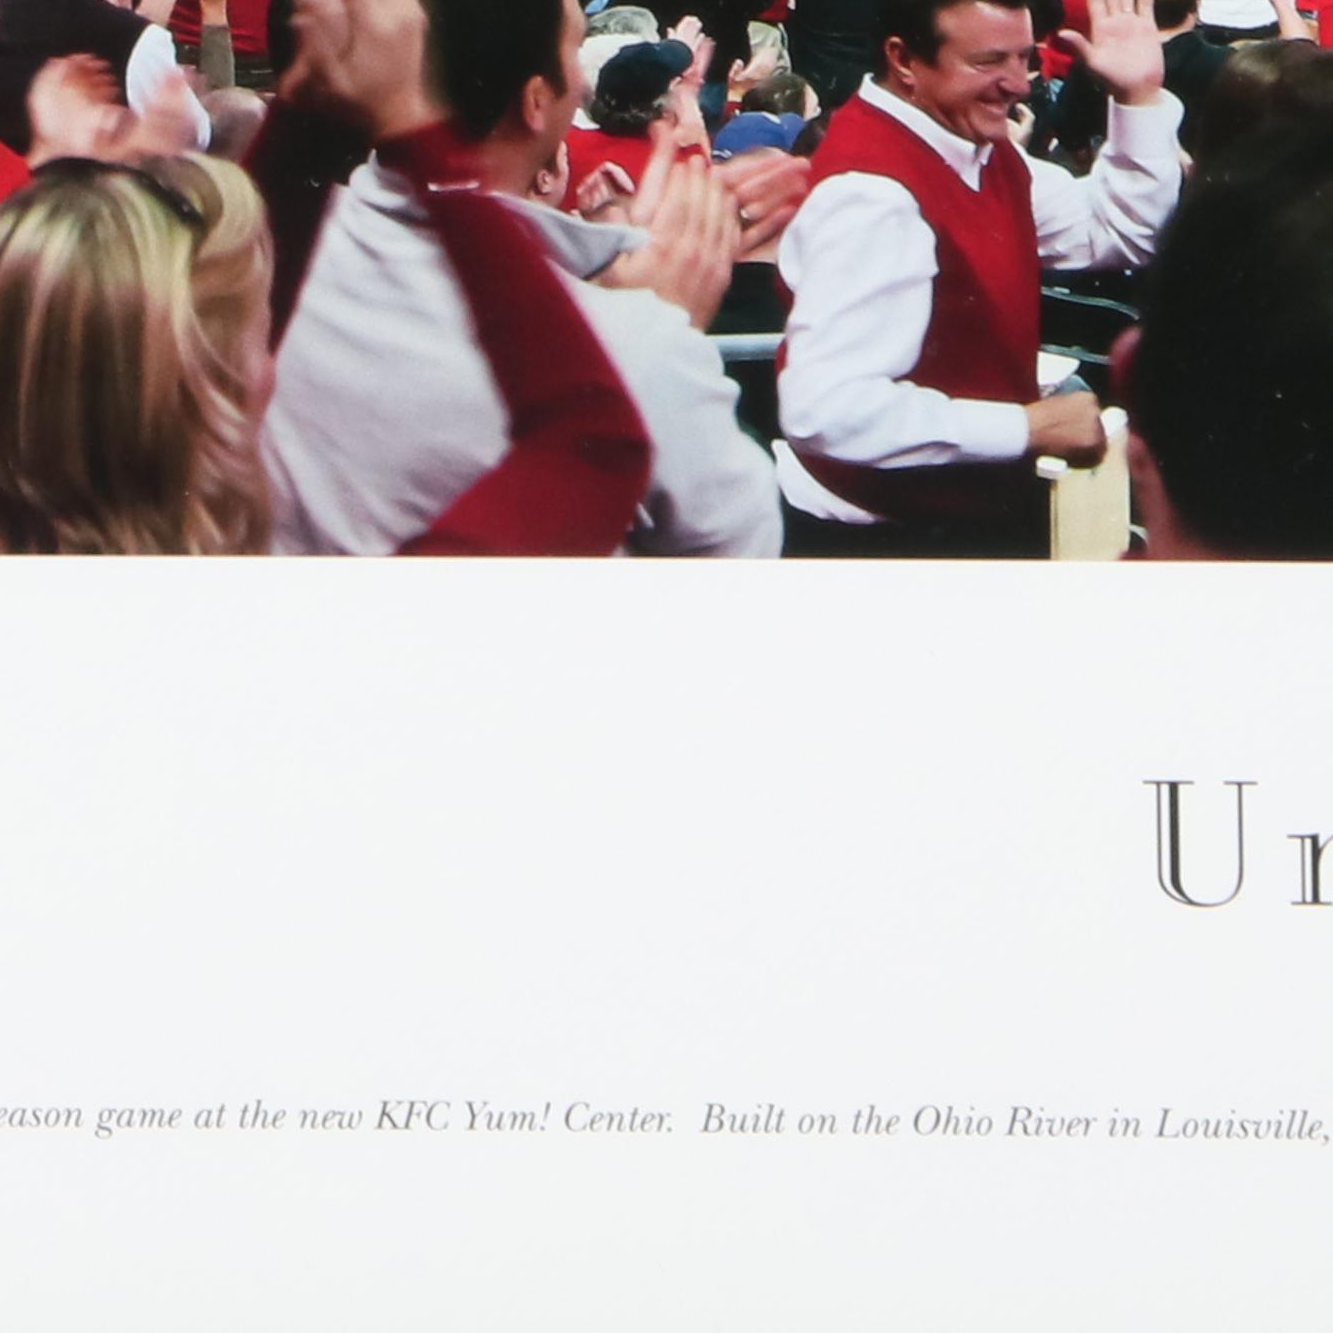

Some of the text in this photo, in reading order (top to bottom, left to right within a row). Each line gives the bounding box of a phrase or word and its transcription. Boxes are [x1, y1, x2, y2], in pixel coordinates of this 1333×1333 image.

[94, 1108, 183, 1139] game
[193, 1103, 226, 1129] at
[238, 1098, 287, 1130] the
[300, 1109, 363, 1130] new
[375, 1099, 451, 1131] KFC
[465, 1100, 552, 1132] Yum!
[563, 1102, 673, 1133] Center.
[700, 1102, 785, 1134] Built
[797, 1113, 837, 1135] on
[851, 1104, 901, 1135] the
[912, 1105, 994, 1136] Ohio
[1005, 1106, 1098, 1137] River
[1108, 1108, 1141, 1138] in
[1156, 1107, 1330, 1144] Louisville,
